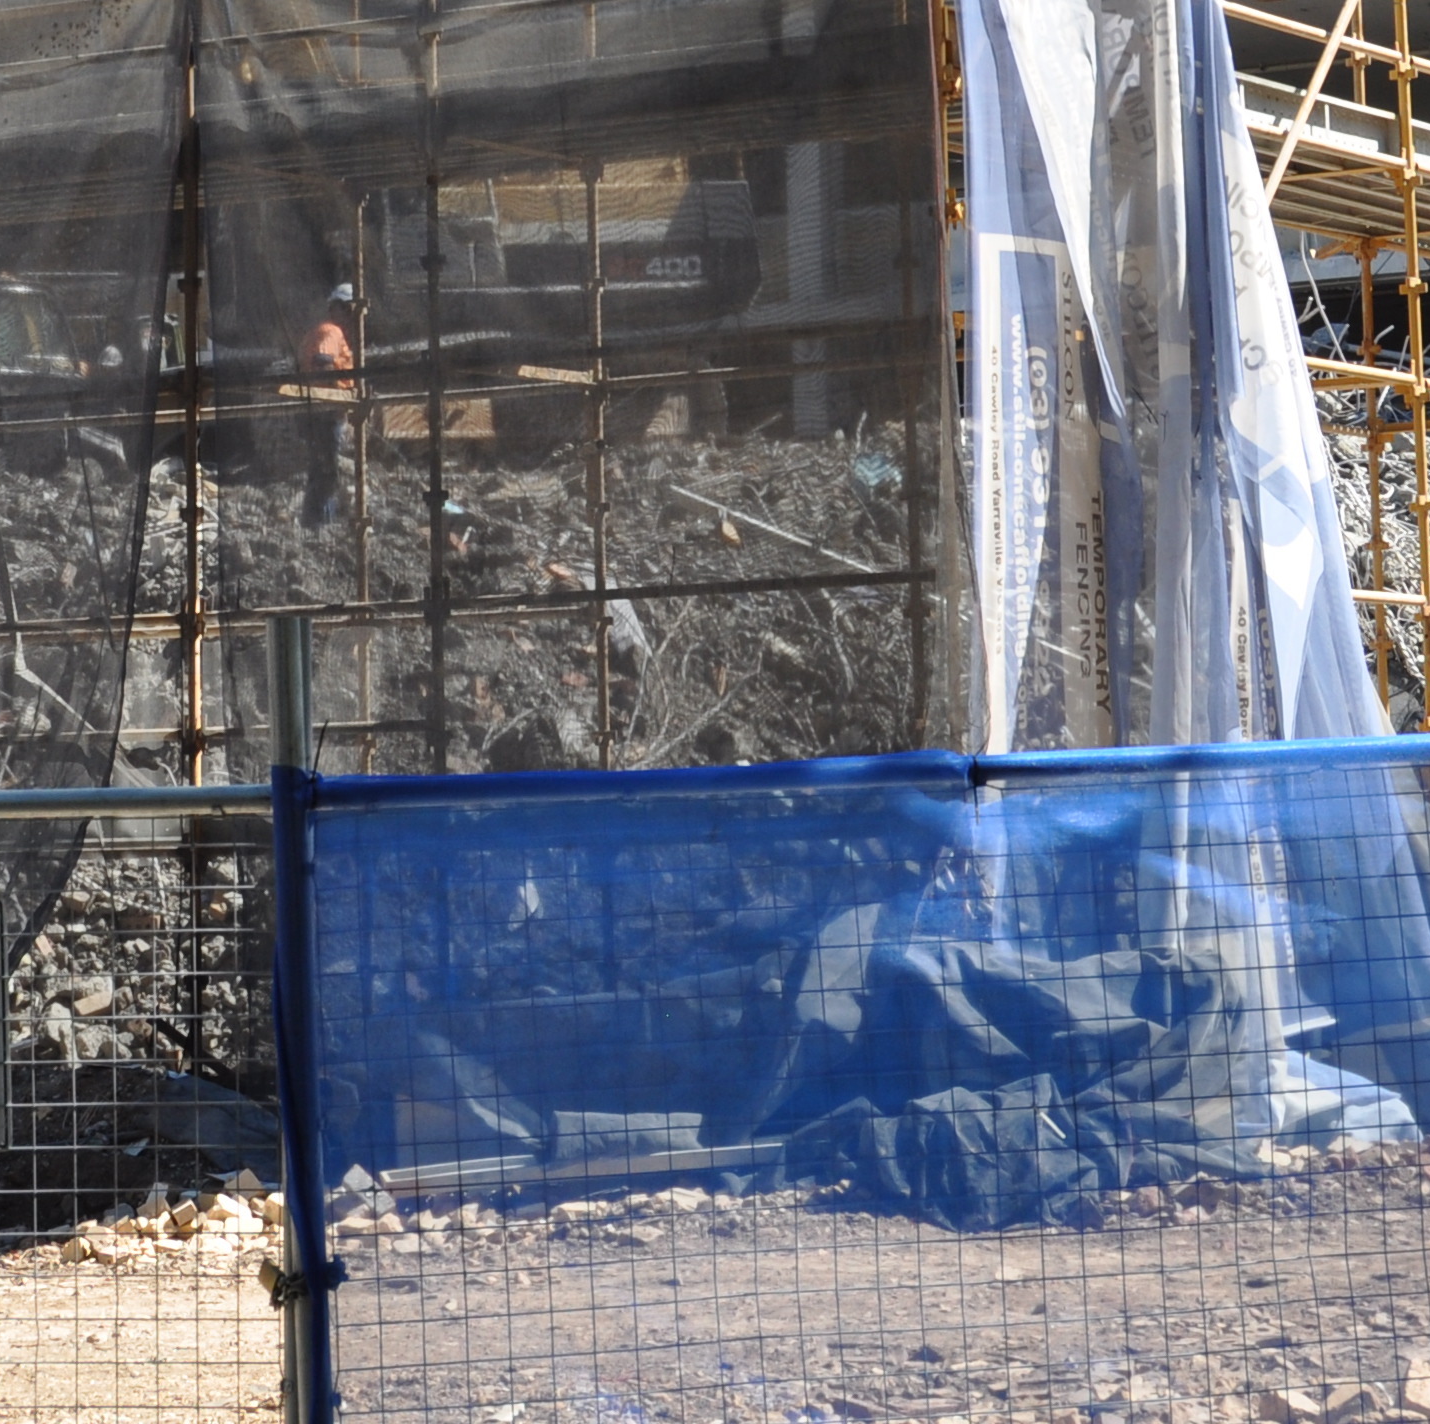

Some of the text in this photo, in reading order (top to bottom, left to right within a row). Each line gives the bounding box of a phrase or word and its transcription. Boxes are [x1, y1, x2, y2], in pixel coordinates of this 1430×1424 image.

[990, 344, 999, 367] 40
[1061, 271, 1076, 423] STILCON
[990, 371, 1000, 433] Cawley
[1024, 346, 1050, 430] (03)
[991, 439, 1001, 482] Road
[1075, 522, 1092, 679] FENCING
[1090, 490, 1111, 716] TEMPORARY
[1237, 606, 1247, 628] 40
